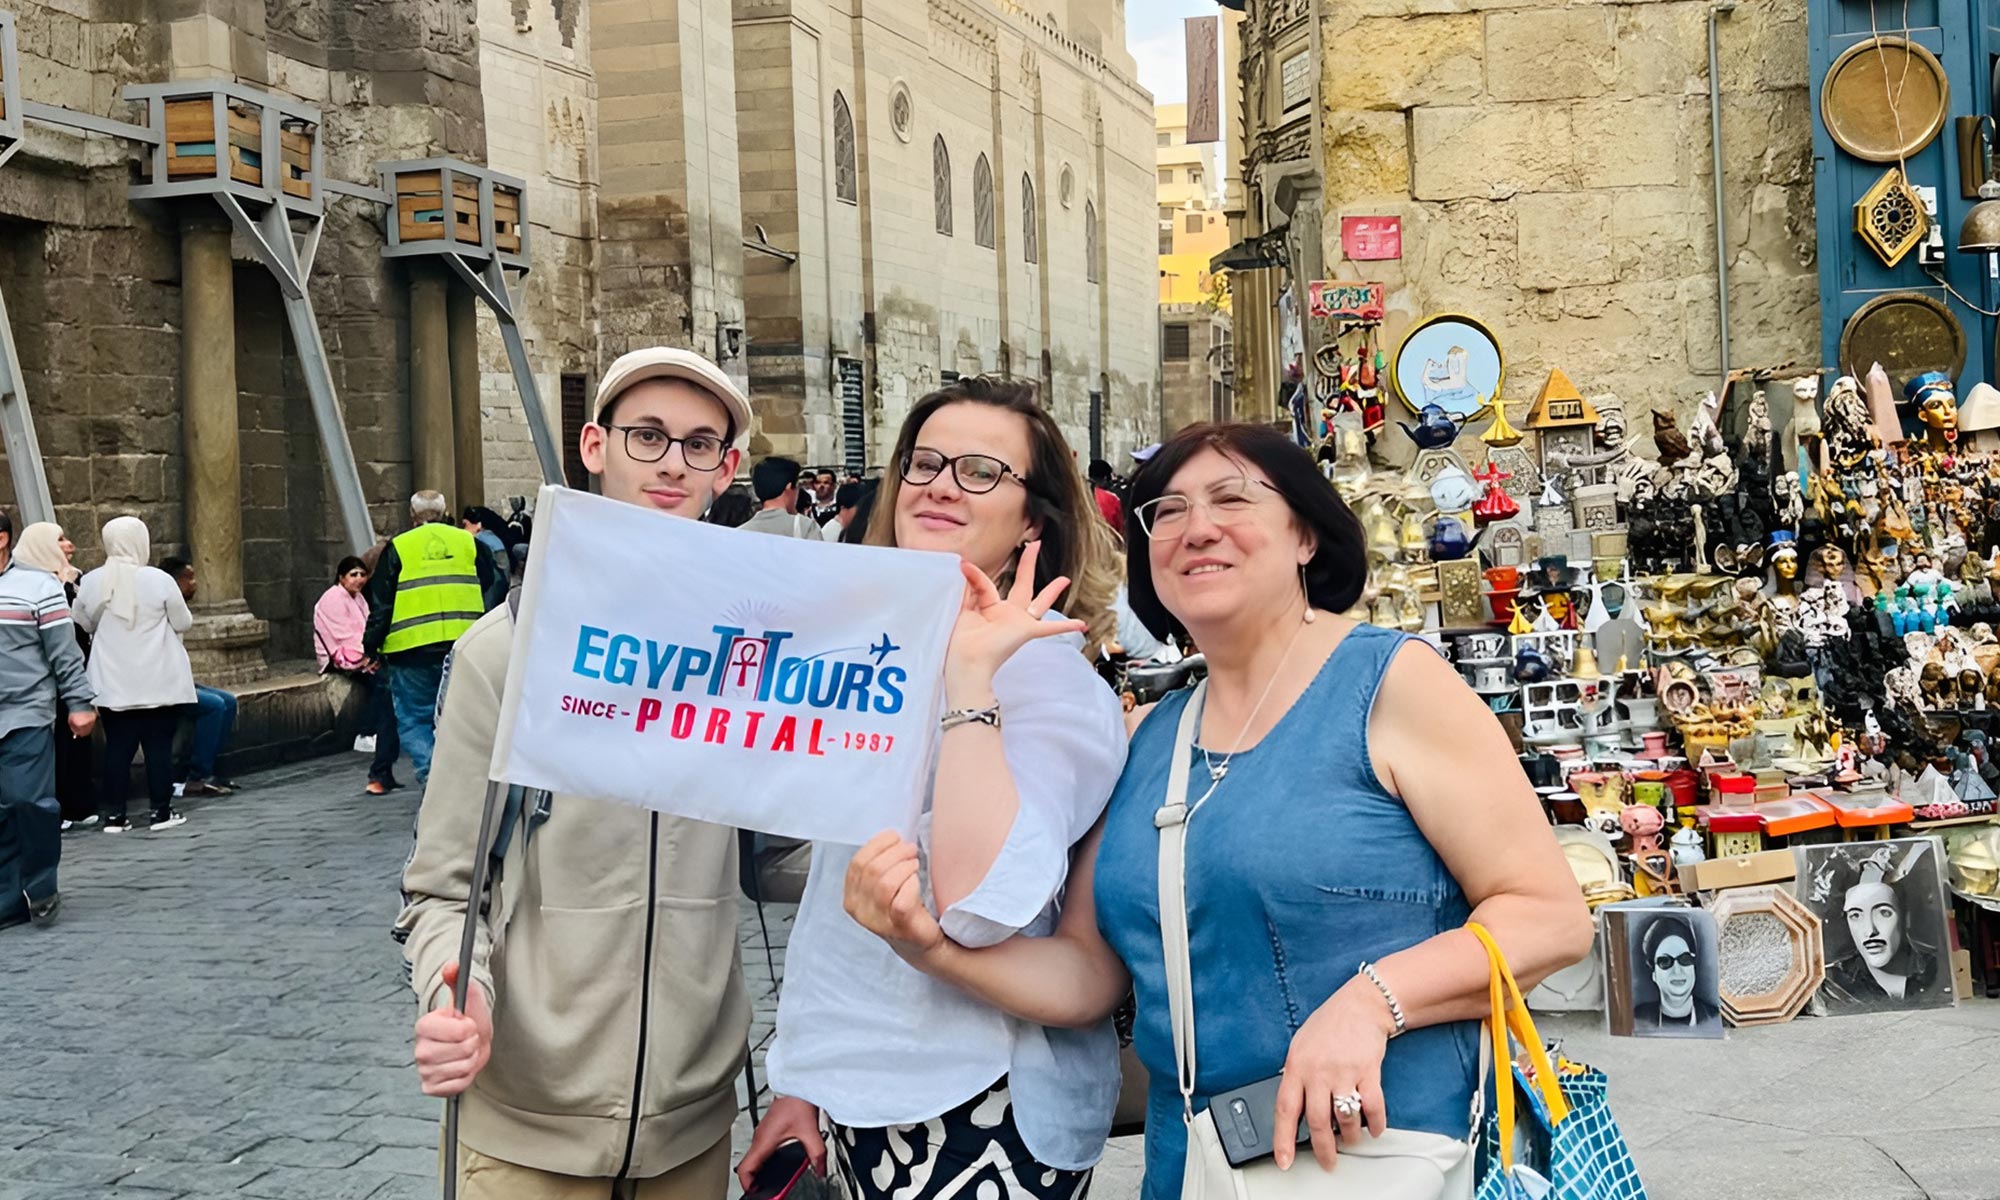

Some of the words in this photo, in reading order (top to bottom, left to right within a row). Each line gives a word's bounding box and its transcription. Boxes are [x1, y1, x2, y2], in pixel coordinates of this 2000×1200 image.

[572, 624, 745, 696] EGYPT
[757, 629, 907, 715] TOURS
[635, 697, 824, 756] PORTAL
